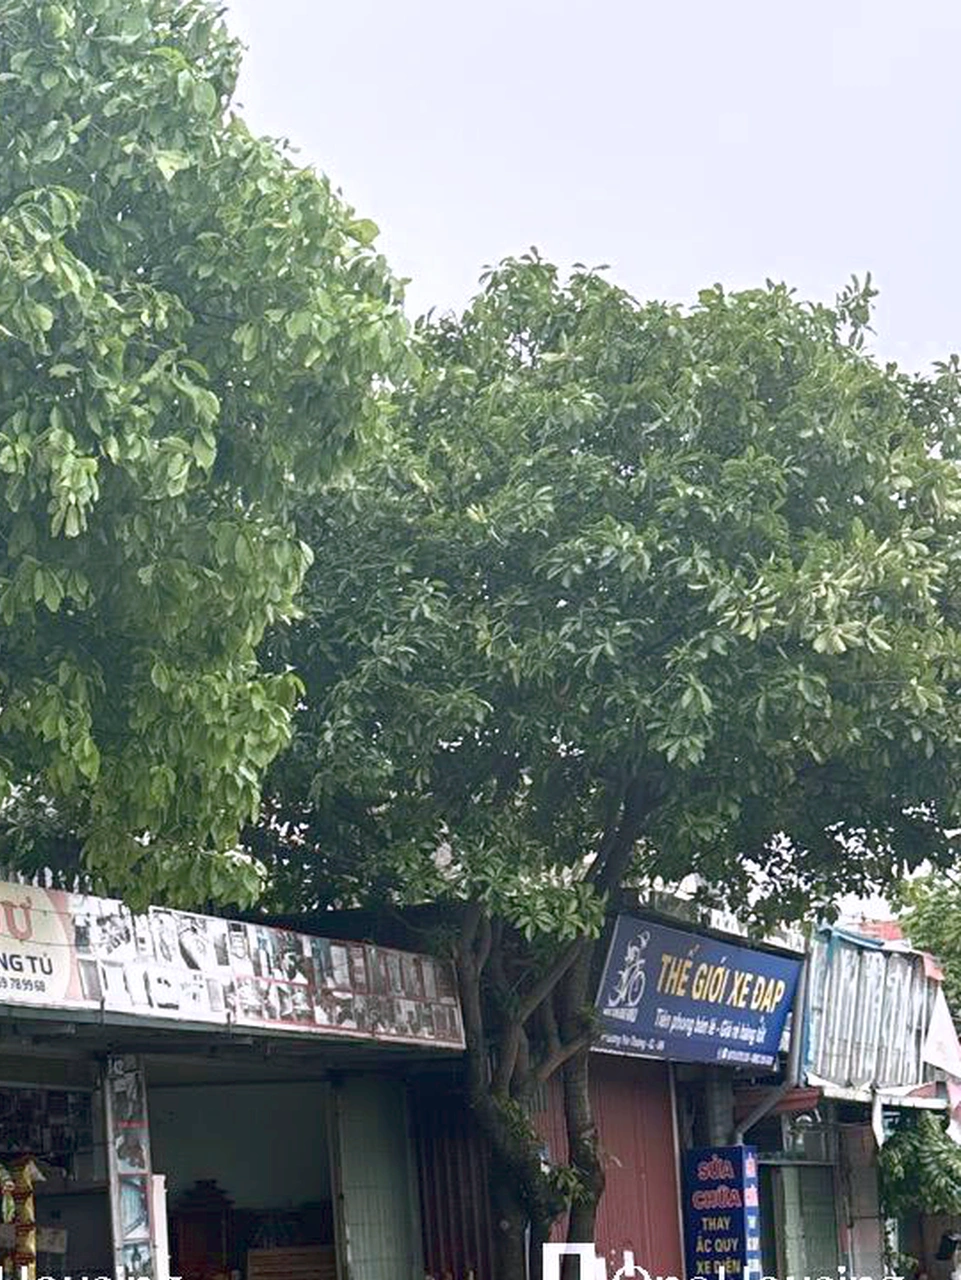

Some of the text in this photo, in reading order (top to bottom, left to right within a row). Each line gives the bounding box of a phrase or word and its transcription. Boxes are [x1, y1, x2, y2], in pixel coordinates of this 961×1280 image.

[657, 944, 699, 997] THẾ
[692, 956, 730, 1004] GIỚI
[728, 971, 752, 1008] XE
[701, 1216, 731, 1231] THAY
[714, 1237, 739, 1253] QUY
[696, 1259, 712, 1275] XE
